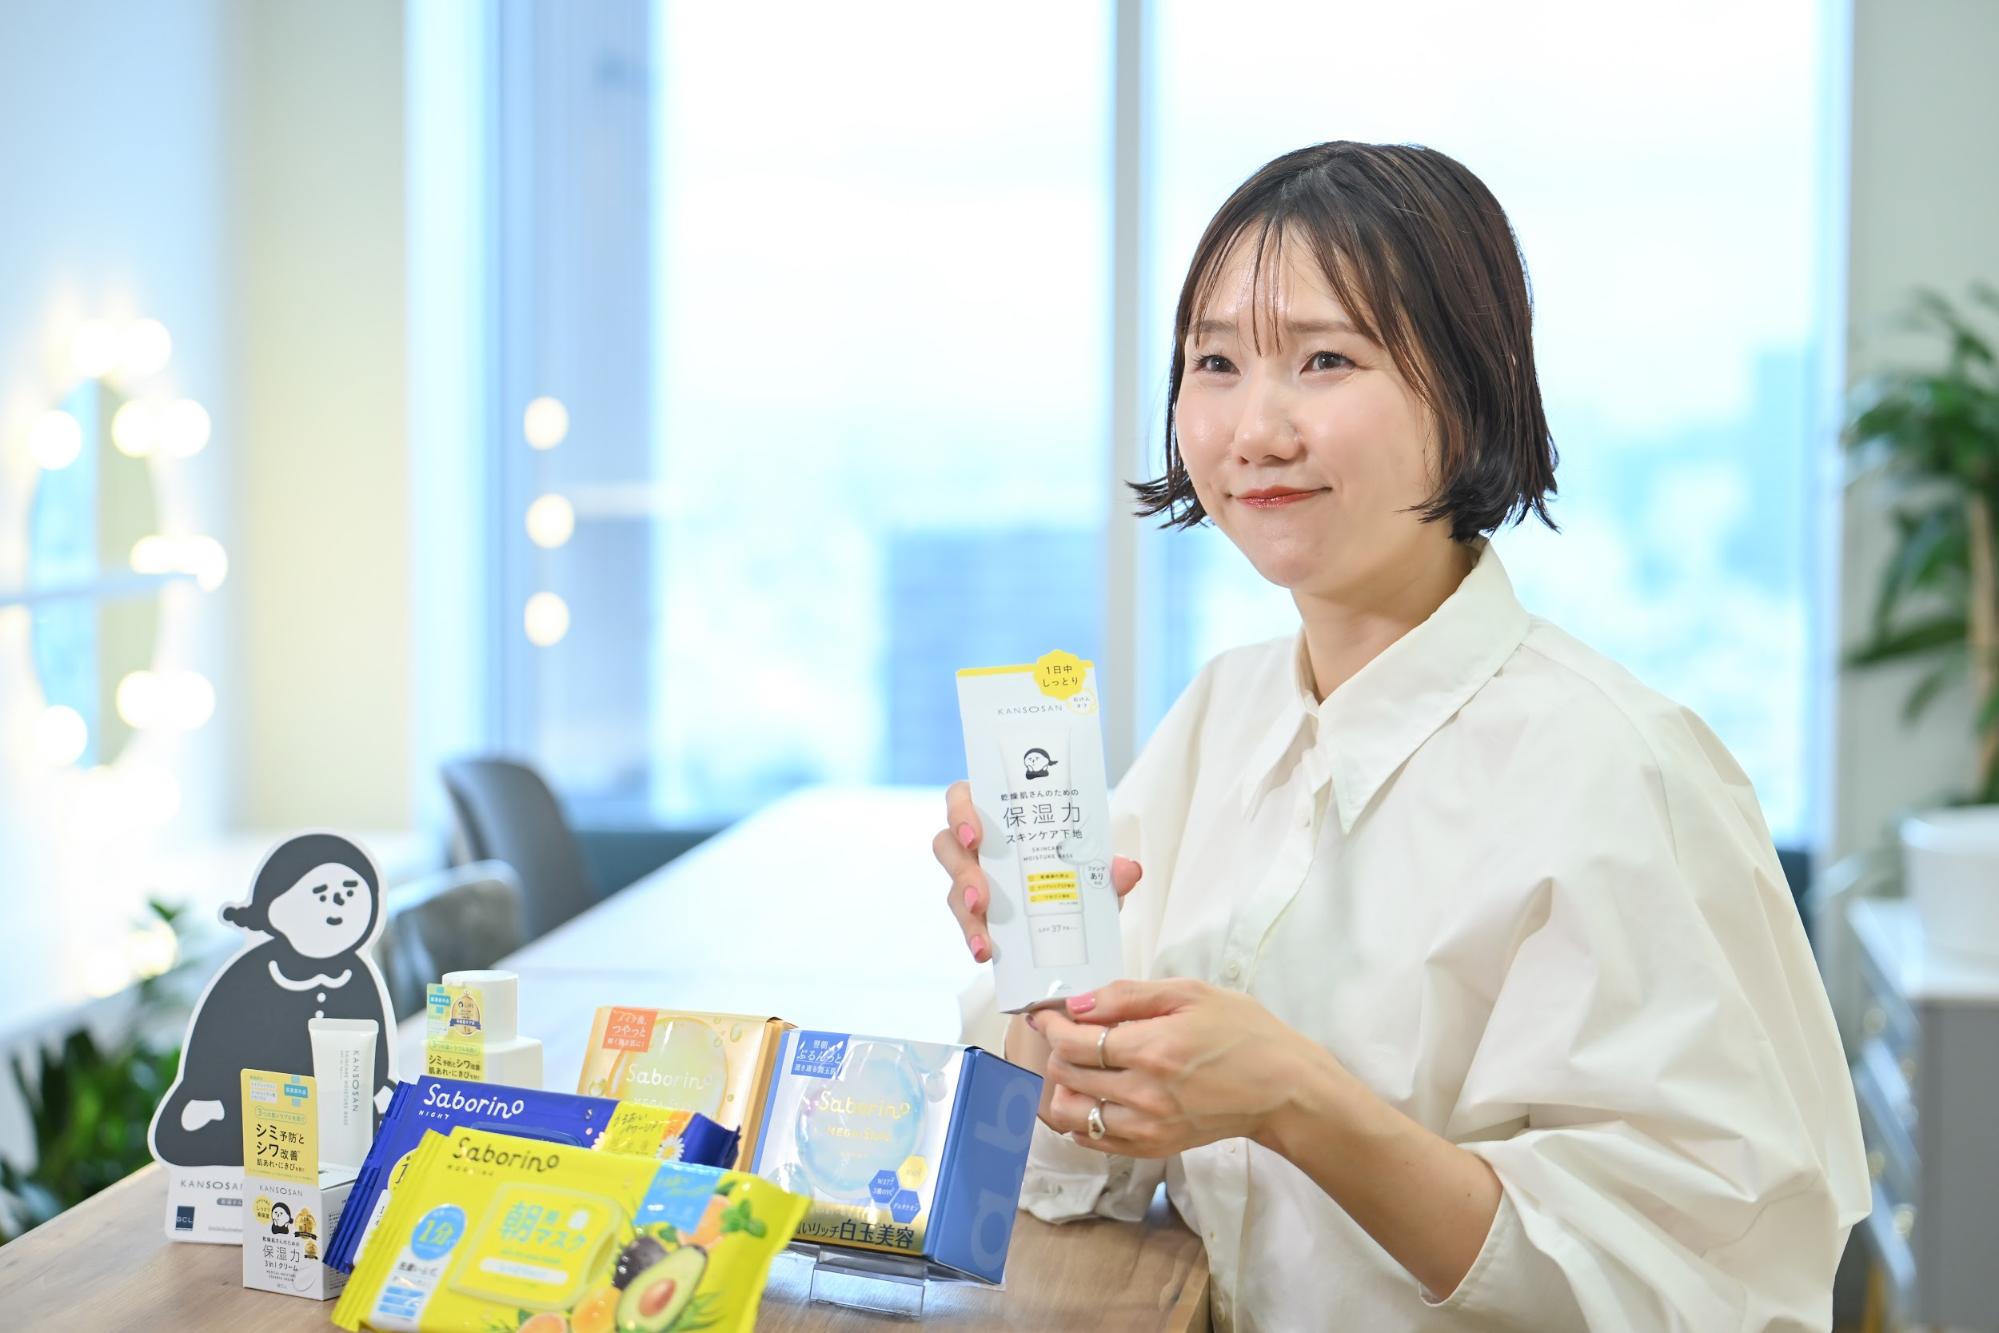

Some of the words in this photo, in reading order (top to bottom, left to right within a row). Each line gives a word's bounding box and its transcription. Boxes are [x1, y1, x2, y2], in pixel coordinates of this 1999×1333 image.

[1046, 665, 1073, 675] 1日中
[1042, 676, 1078, 688] しっとり
[997, 705, 1063, 715] KANSOSAN
[1000, 789, 1079, 801] 乾燥肌さんのための
[1003, 802, 1080, 829] 保湿力
[1006, 829, 1083, 844] スキンケア下地
[1090, 872, 1104, 881] あり
[352, 1049, 360, 1112] KANSOSAN
[424, 1083, 524, 1119] Saborino
[418, 1110, 450, 1120] NIGHT
[453, 1137, 560, 1172] Saborino
[260, 1185, 303, 1196] KANSOSAN
[262, 1244, 300, 1263] 保湿力
